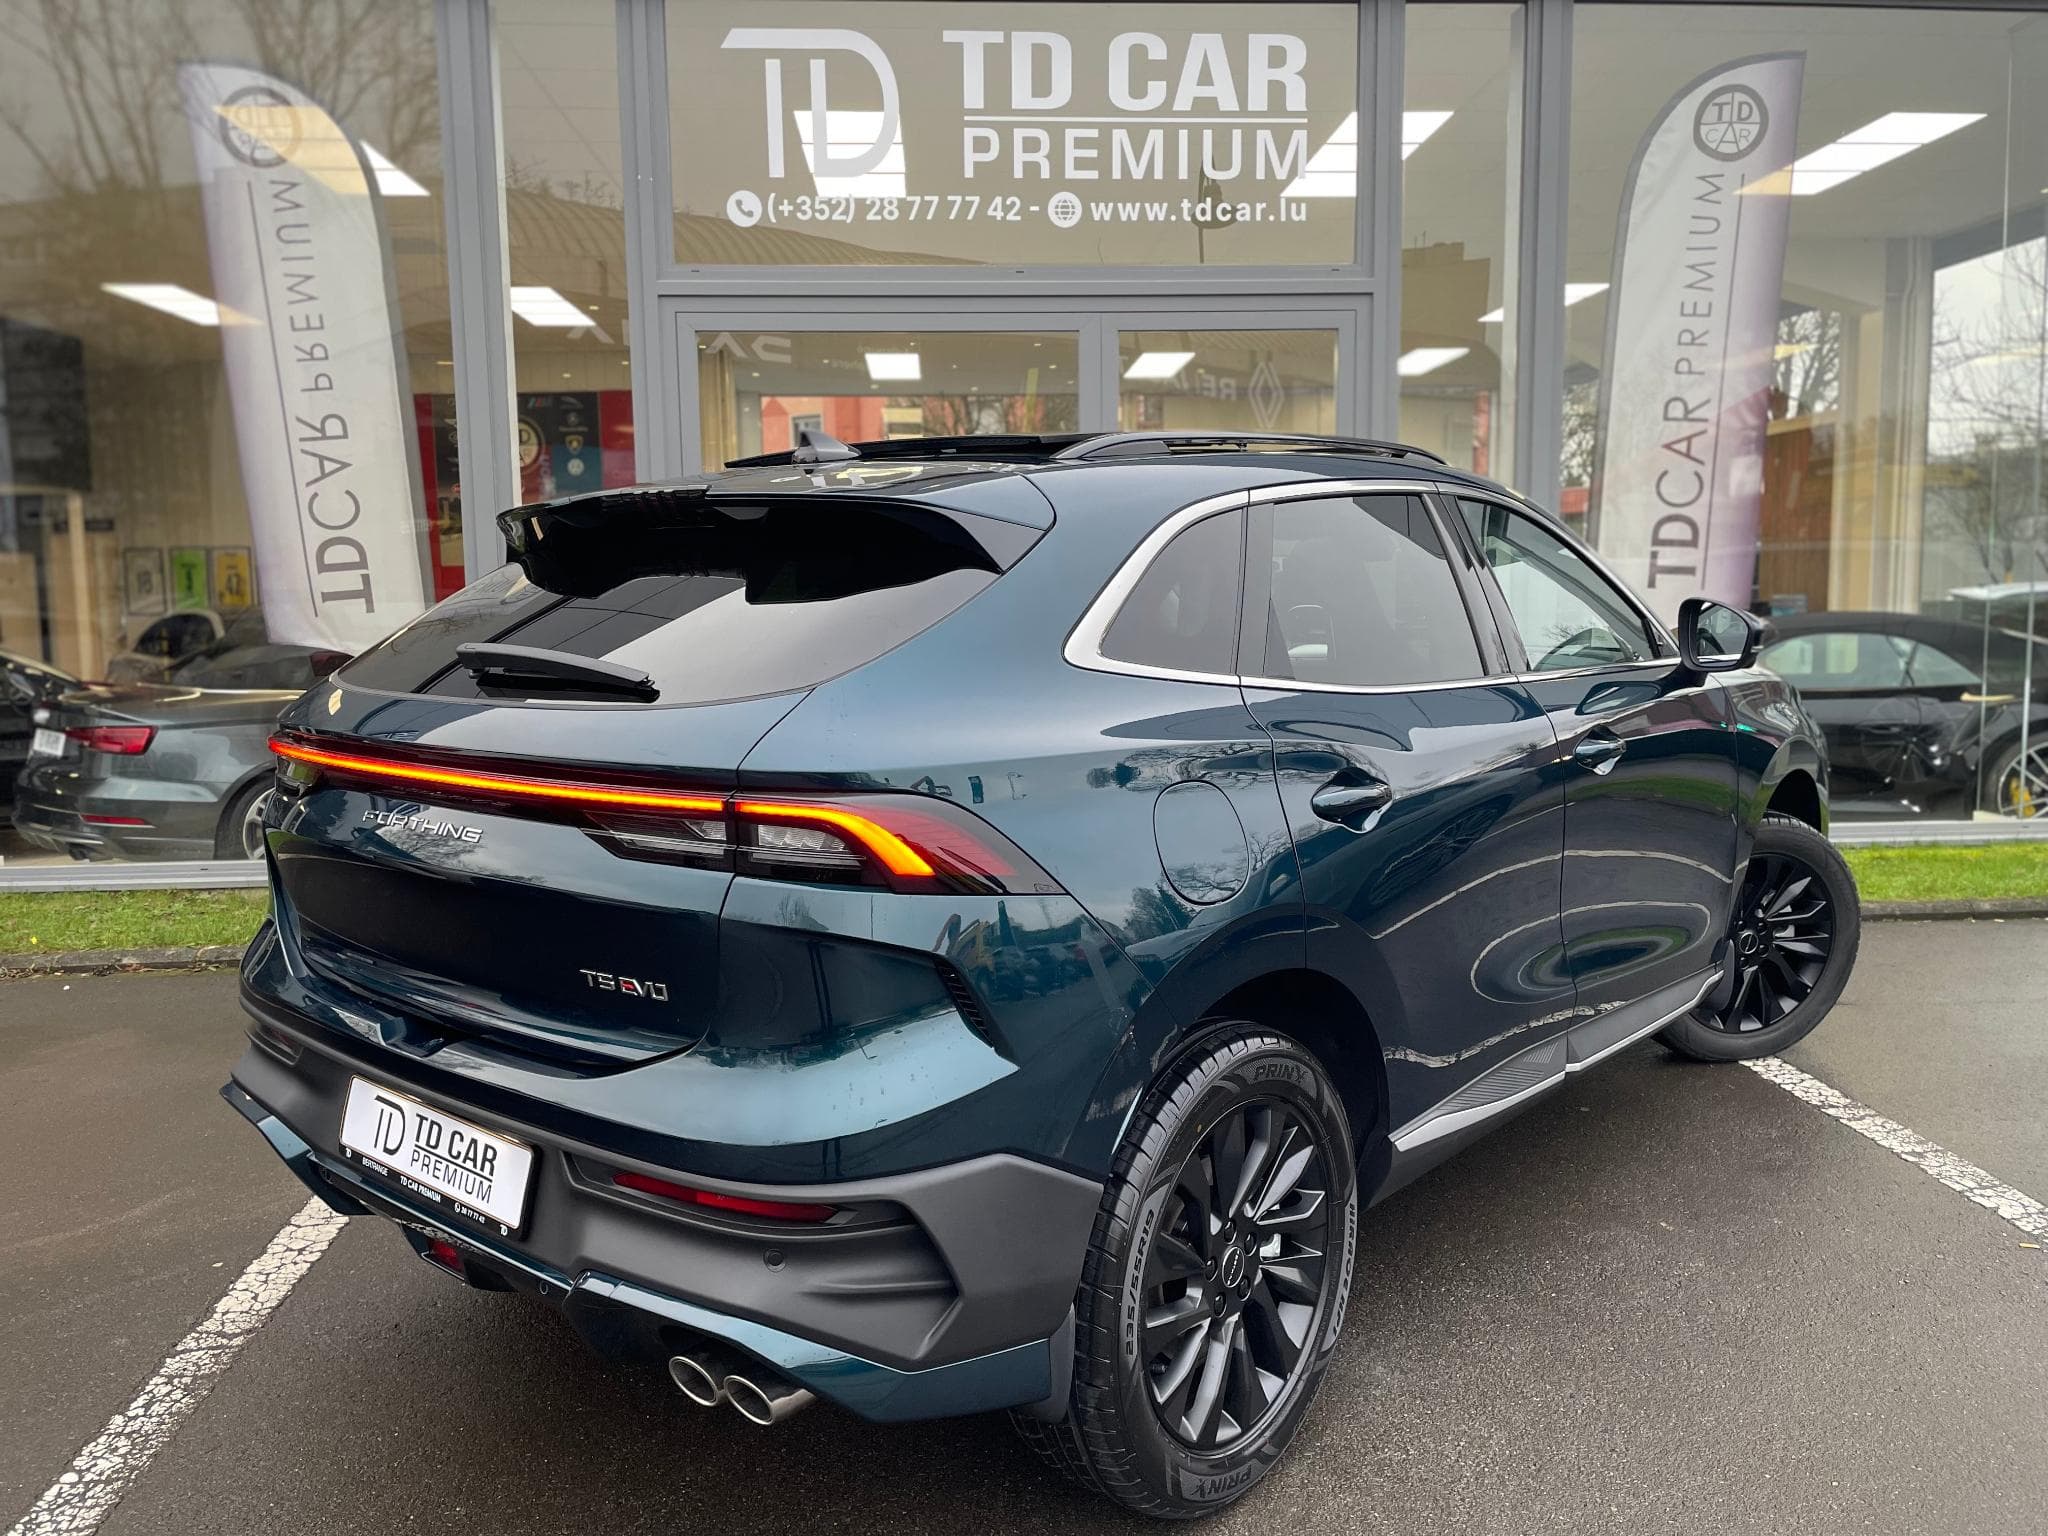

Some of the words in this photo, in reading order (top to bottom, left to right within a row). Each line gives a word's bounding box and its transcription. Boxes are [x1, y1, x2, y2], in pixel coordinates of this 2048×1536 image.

[943, 30, 1072, 110] TD
[1108, 32, 1308, 111] CAR
[1705, 122, 1751, 152] CAR
[1711, 101, 1753, 122] TD
[964, 127, 1308, 180] PREMIUM
[767, 193, 856, 223] (+352)
[866, 196, 900, 222] 28
[906, 195, 939, 221] 77
[947, 195, 981, 221] 77
[987, 196, 1022, 222] 42
[1090, 197, 1307, 222] www.tdcar.lu
[1676, 173, 1725, 376] PREMIUM
[1648, 396, 1711, 590] TDCAR
[362, 810, 484, 844] FORTHING
[1253, 1063, 1309, 1083] PRINX
[414, 1113, 443, 1150] TD
[447, 1130, 498, 1177] CAR
[410, 1149, 493, 1204] PREMIUM
[1125, 1208, 1155, 1356] 235/55R19
[1190, 1463, 1253, 1499] PRINX
